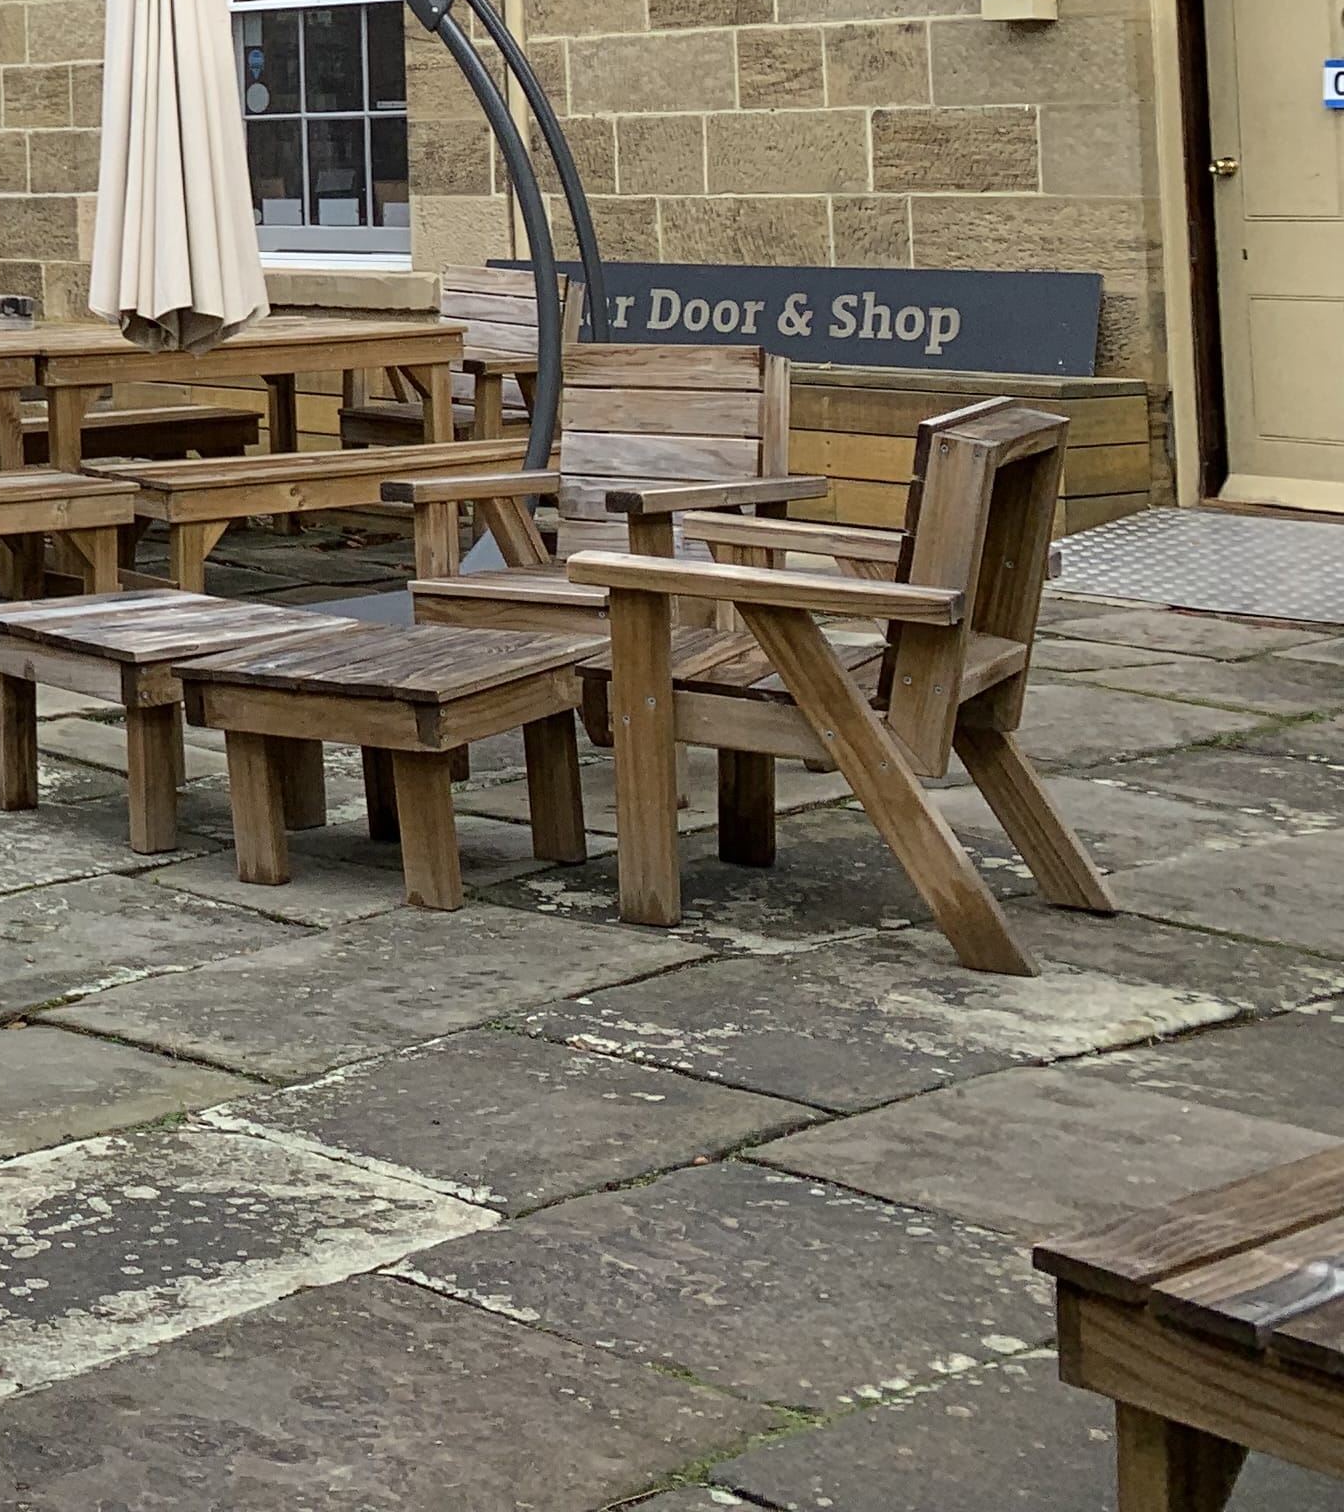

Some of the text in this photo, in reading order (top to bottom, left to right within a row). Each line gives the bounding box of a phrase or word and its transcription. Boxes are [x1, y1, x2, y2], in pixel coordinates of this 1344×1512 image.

[647, 288, 765, 334] Door
[777, 292, 814, 336] &
[829, 291, 961, 355] Shop
